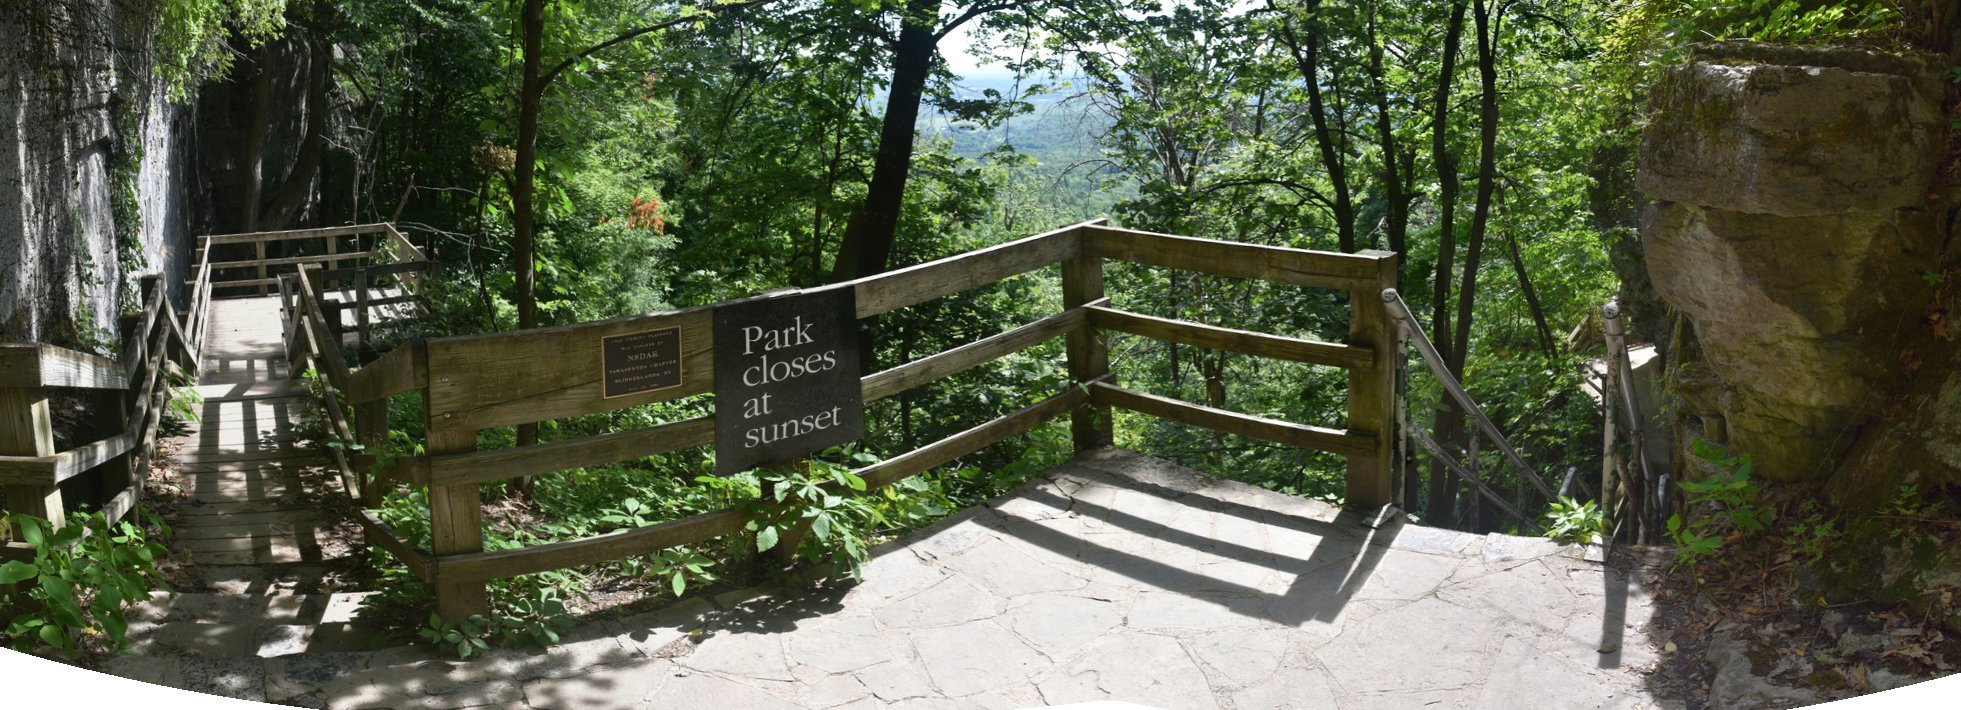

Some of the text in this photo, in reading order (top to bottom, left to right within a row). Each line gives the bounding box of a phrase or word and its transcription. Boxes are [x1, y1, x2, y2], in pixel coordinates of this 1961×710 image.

[742, 315, 814, 355] Park
[628, 351, 658, 361] NSDAR
[742, 350, 836, 387] closes
[743, 392, 773, 419] at
[744, 405, 842, 448] sunset
